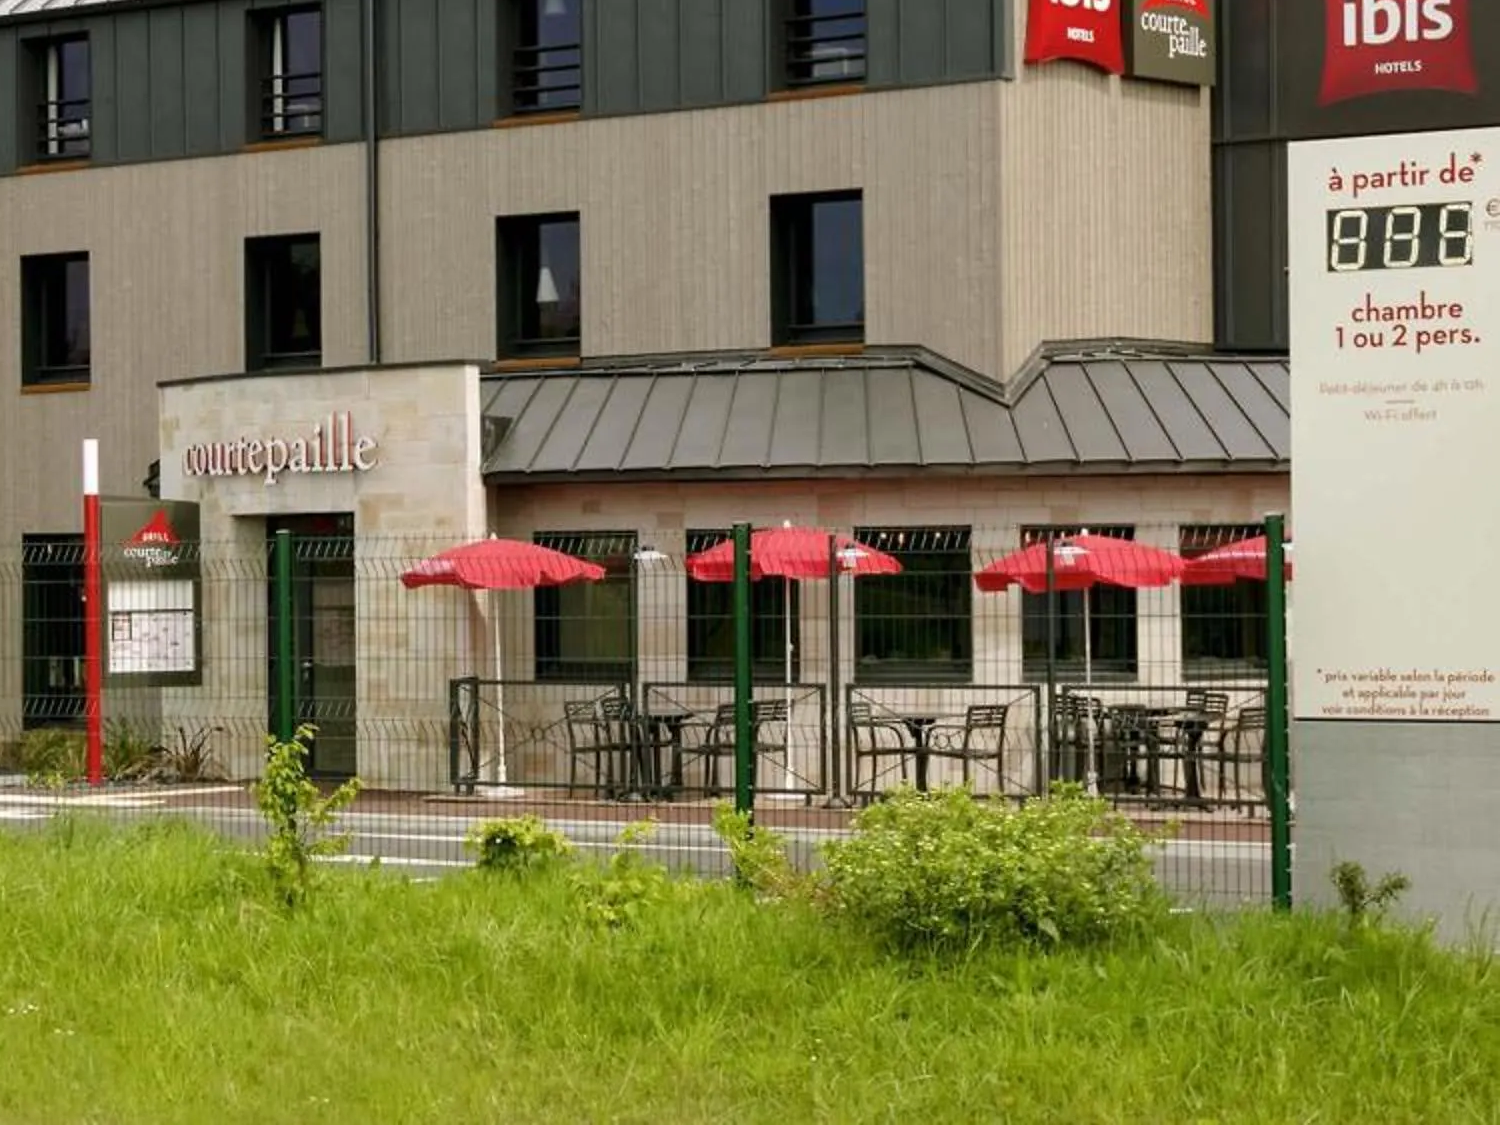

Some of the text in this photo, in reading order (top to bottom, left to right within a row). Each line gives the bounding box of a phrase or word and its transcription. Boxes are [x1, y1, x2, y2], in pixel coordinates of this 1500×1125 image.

[1169, 26, 1207, 58] paille
[1375, 60, 1422, 74] HOTELS
[1329, 167, 1343, 191] à
[1353, 161, 1430, 198] partir
[1351, 291, 1464, 323] chambre
[1336, 325, 1481, 354] 1 ou 2 pers.
[184, 411, 378, 485] courtepaille
